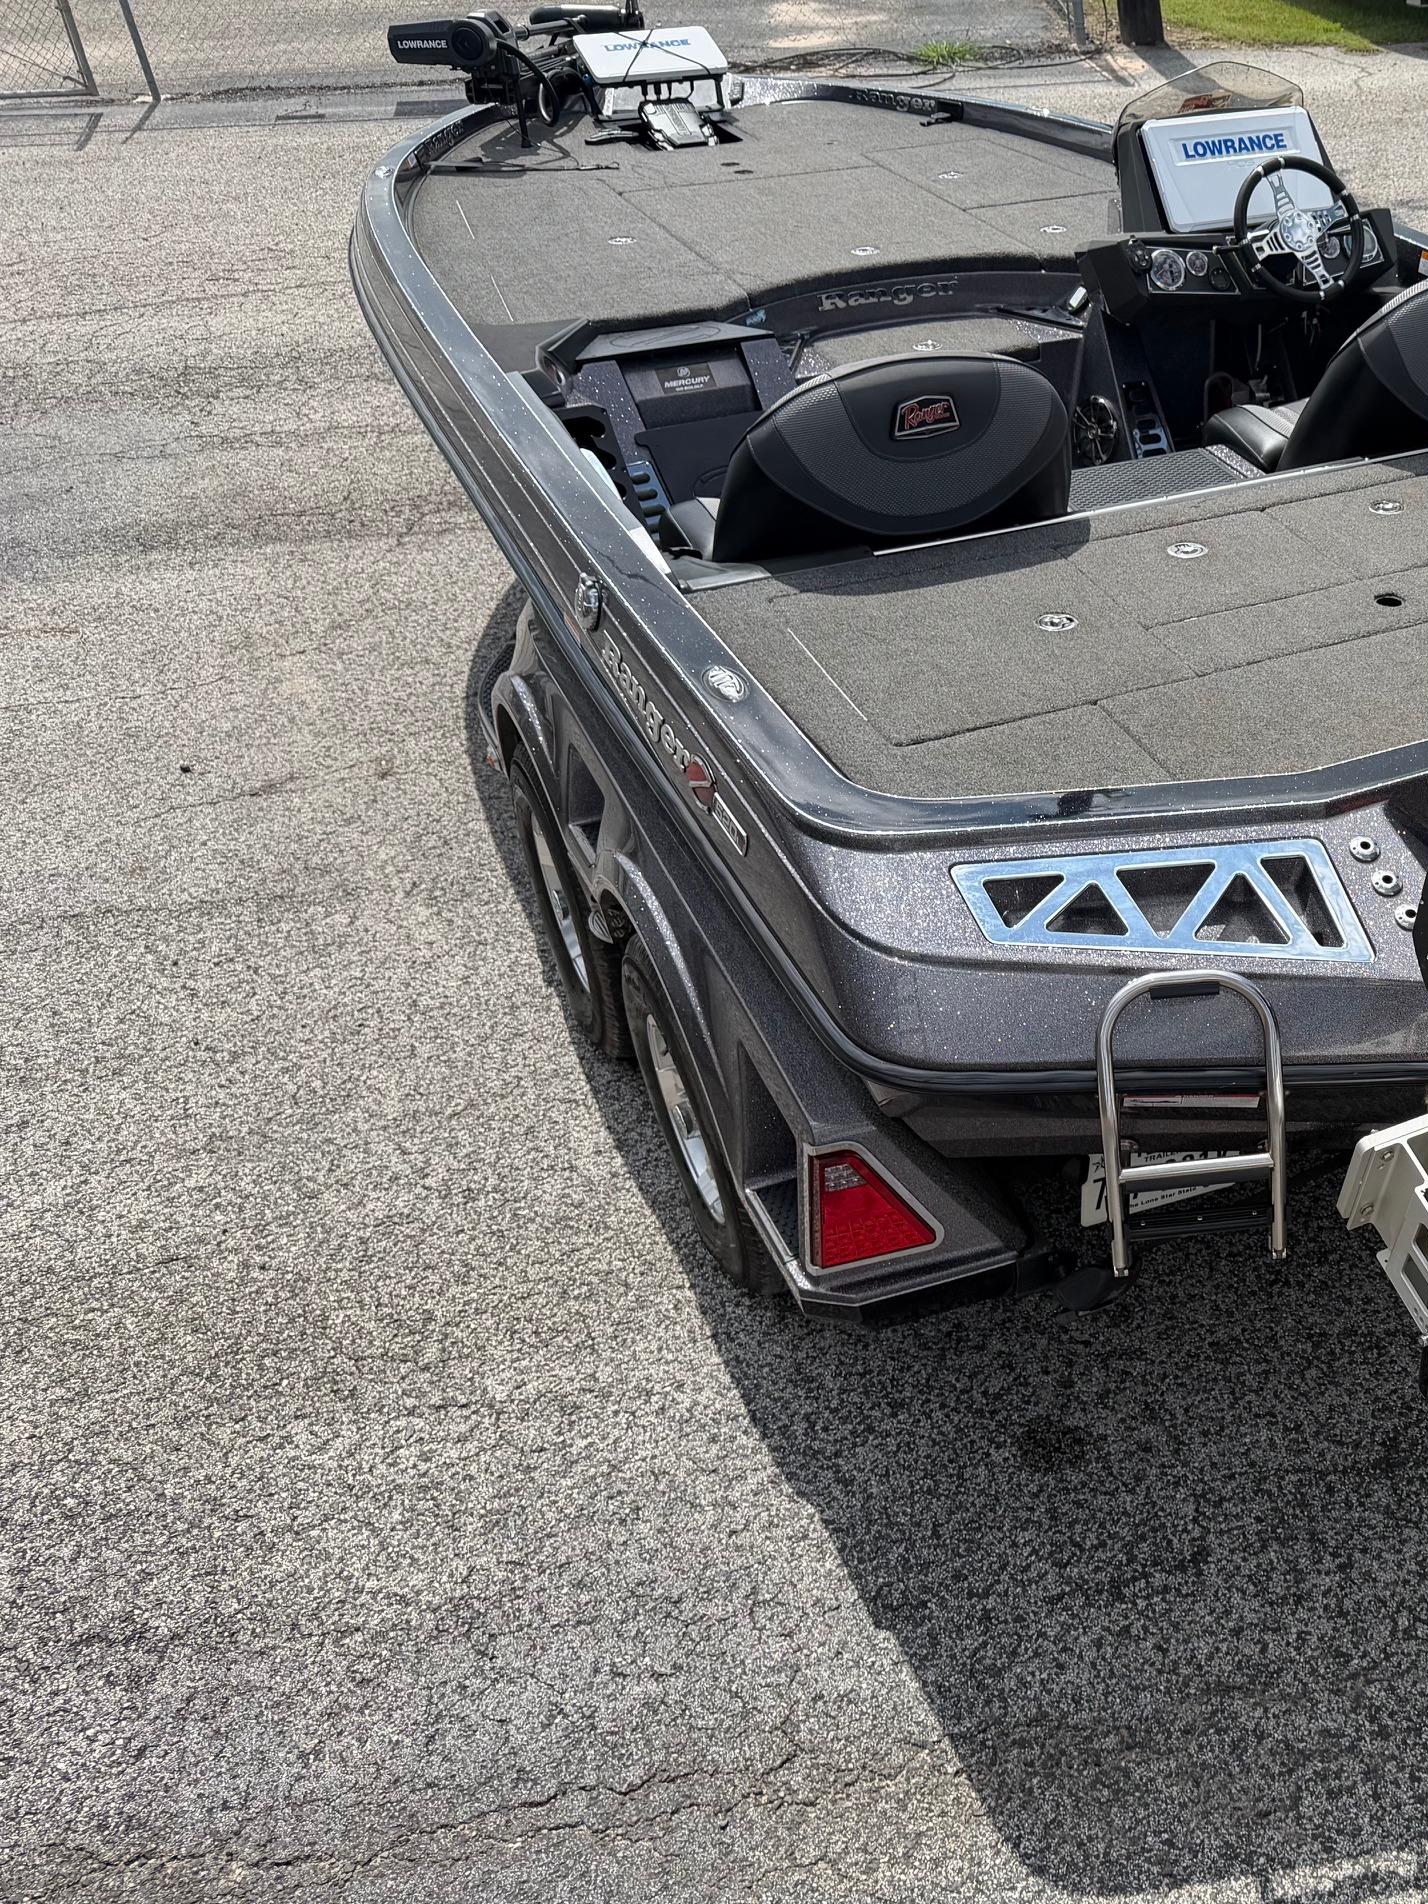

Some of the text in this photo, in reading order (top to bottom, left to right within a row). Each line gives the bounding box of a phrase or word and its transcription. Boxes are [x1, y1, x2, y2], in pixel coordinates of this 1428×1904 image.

[398, 40, 448, 49] LOWRANCE
[604, 38, 692, 52] LOWRANCE
[1181, 132, 1288, 159] LOWRANCE
[817, 280, 959, 312] Ranger
[664, 375, 710, 389] MERCURY
[901, 401, 950, 430] Ranger
[602, 629, 692, 774] Ranger
